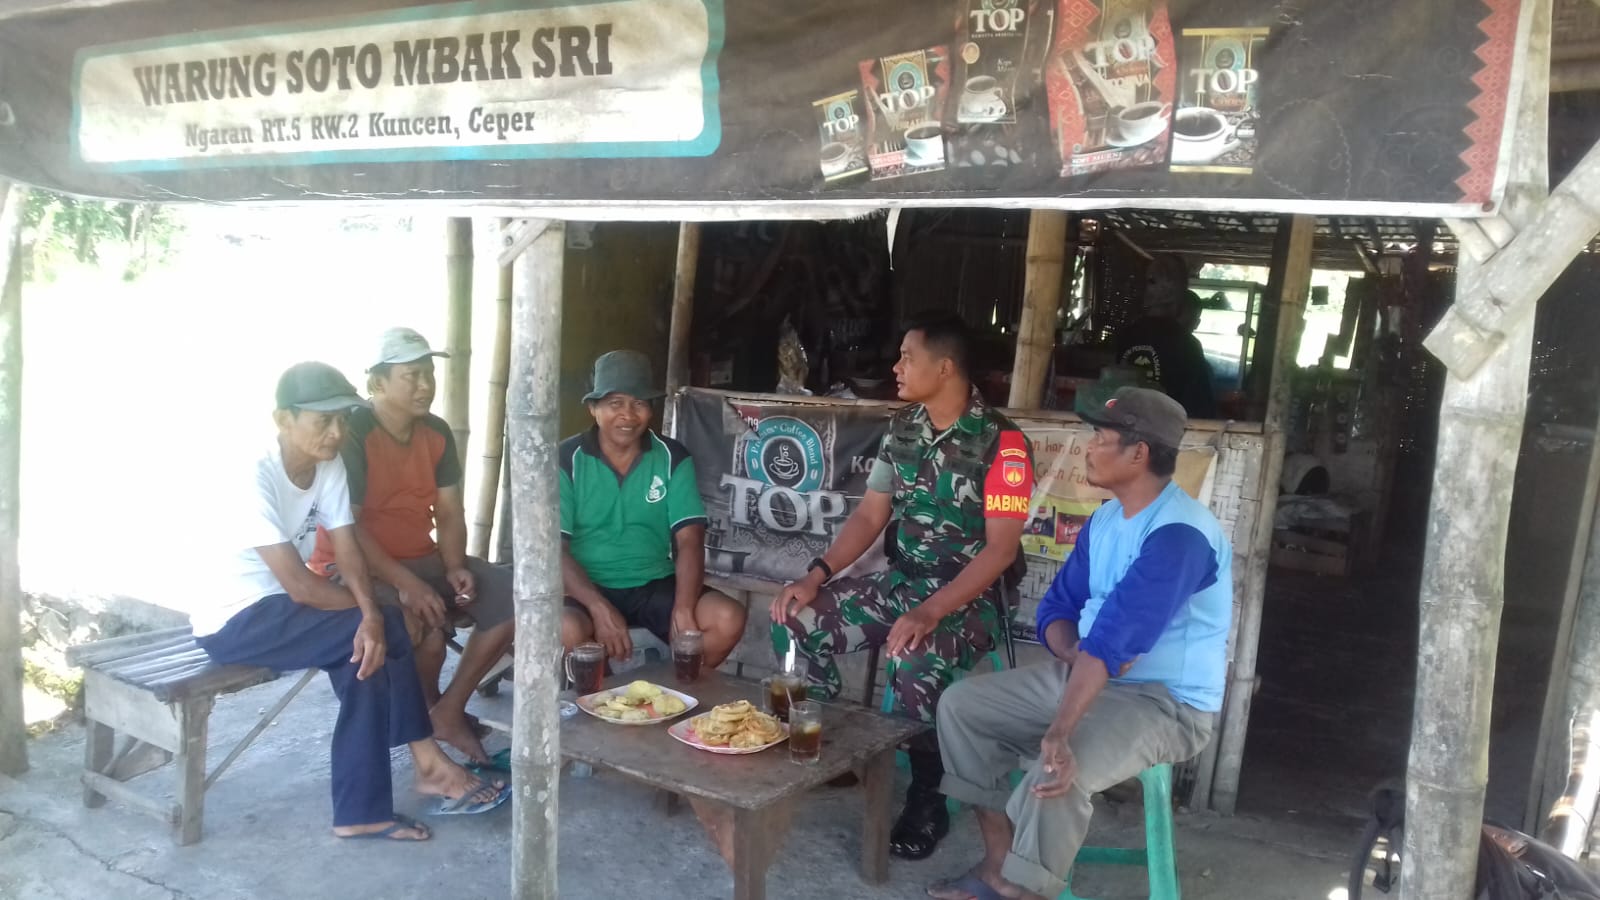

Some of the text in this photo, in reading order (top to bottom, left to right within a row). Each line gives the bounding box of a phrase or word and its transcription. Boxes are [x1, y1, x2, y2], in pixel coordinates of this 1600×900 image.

[970, 8, 1025, 33] TOP
[133, 24, 614, 106] WARUNG SOTO MBAK SRI
[1084, 35, 1156, 69] TOP
[1189, 68, 1259, 94] TOP
[880, 85, 936, 112] TOP
[184, 106, 536, 153] Ngaran RT.5 RW.2 Kuncen, Ceper
[823, 114, 860, 137] TOP
[850, 455, 876, 474] Ko
[719, 473, 848, 536] TOP
[986, 494, 1029, 513] BABINS
